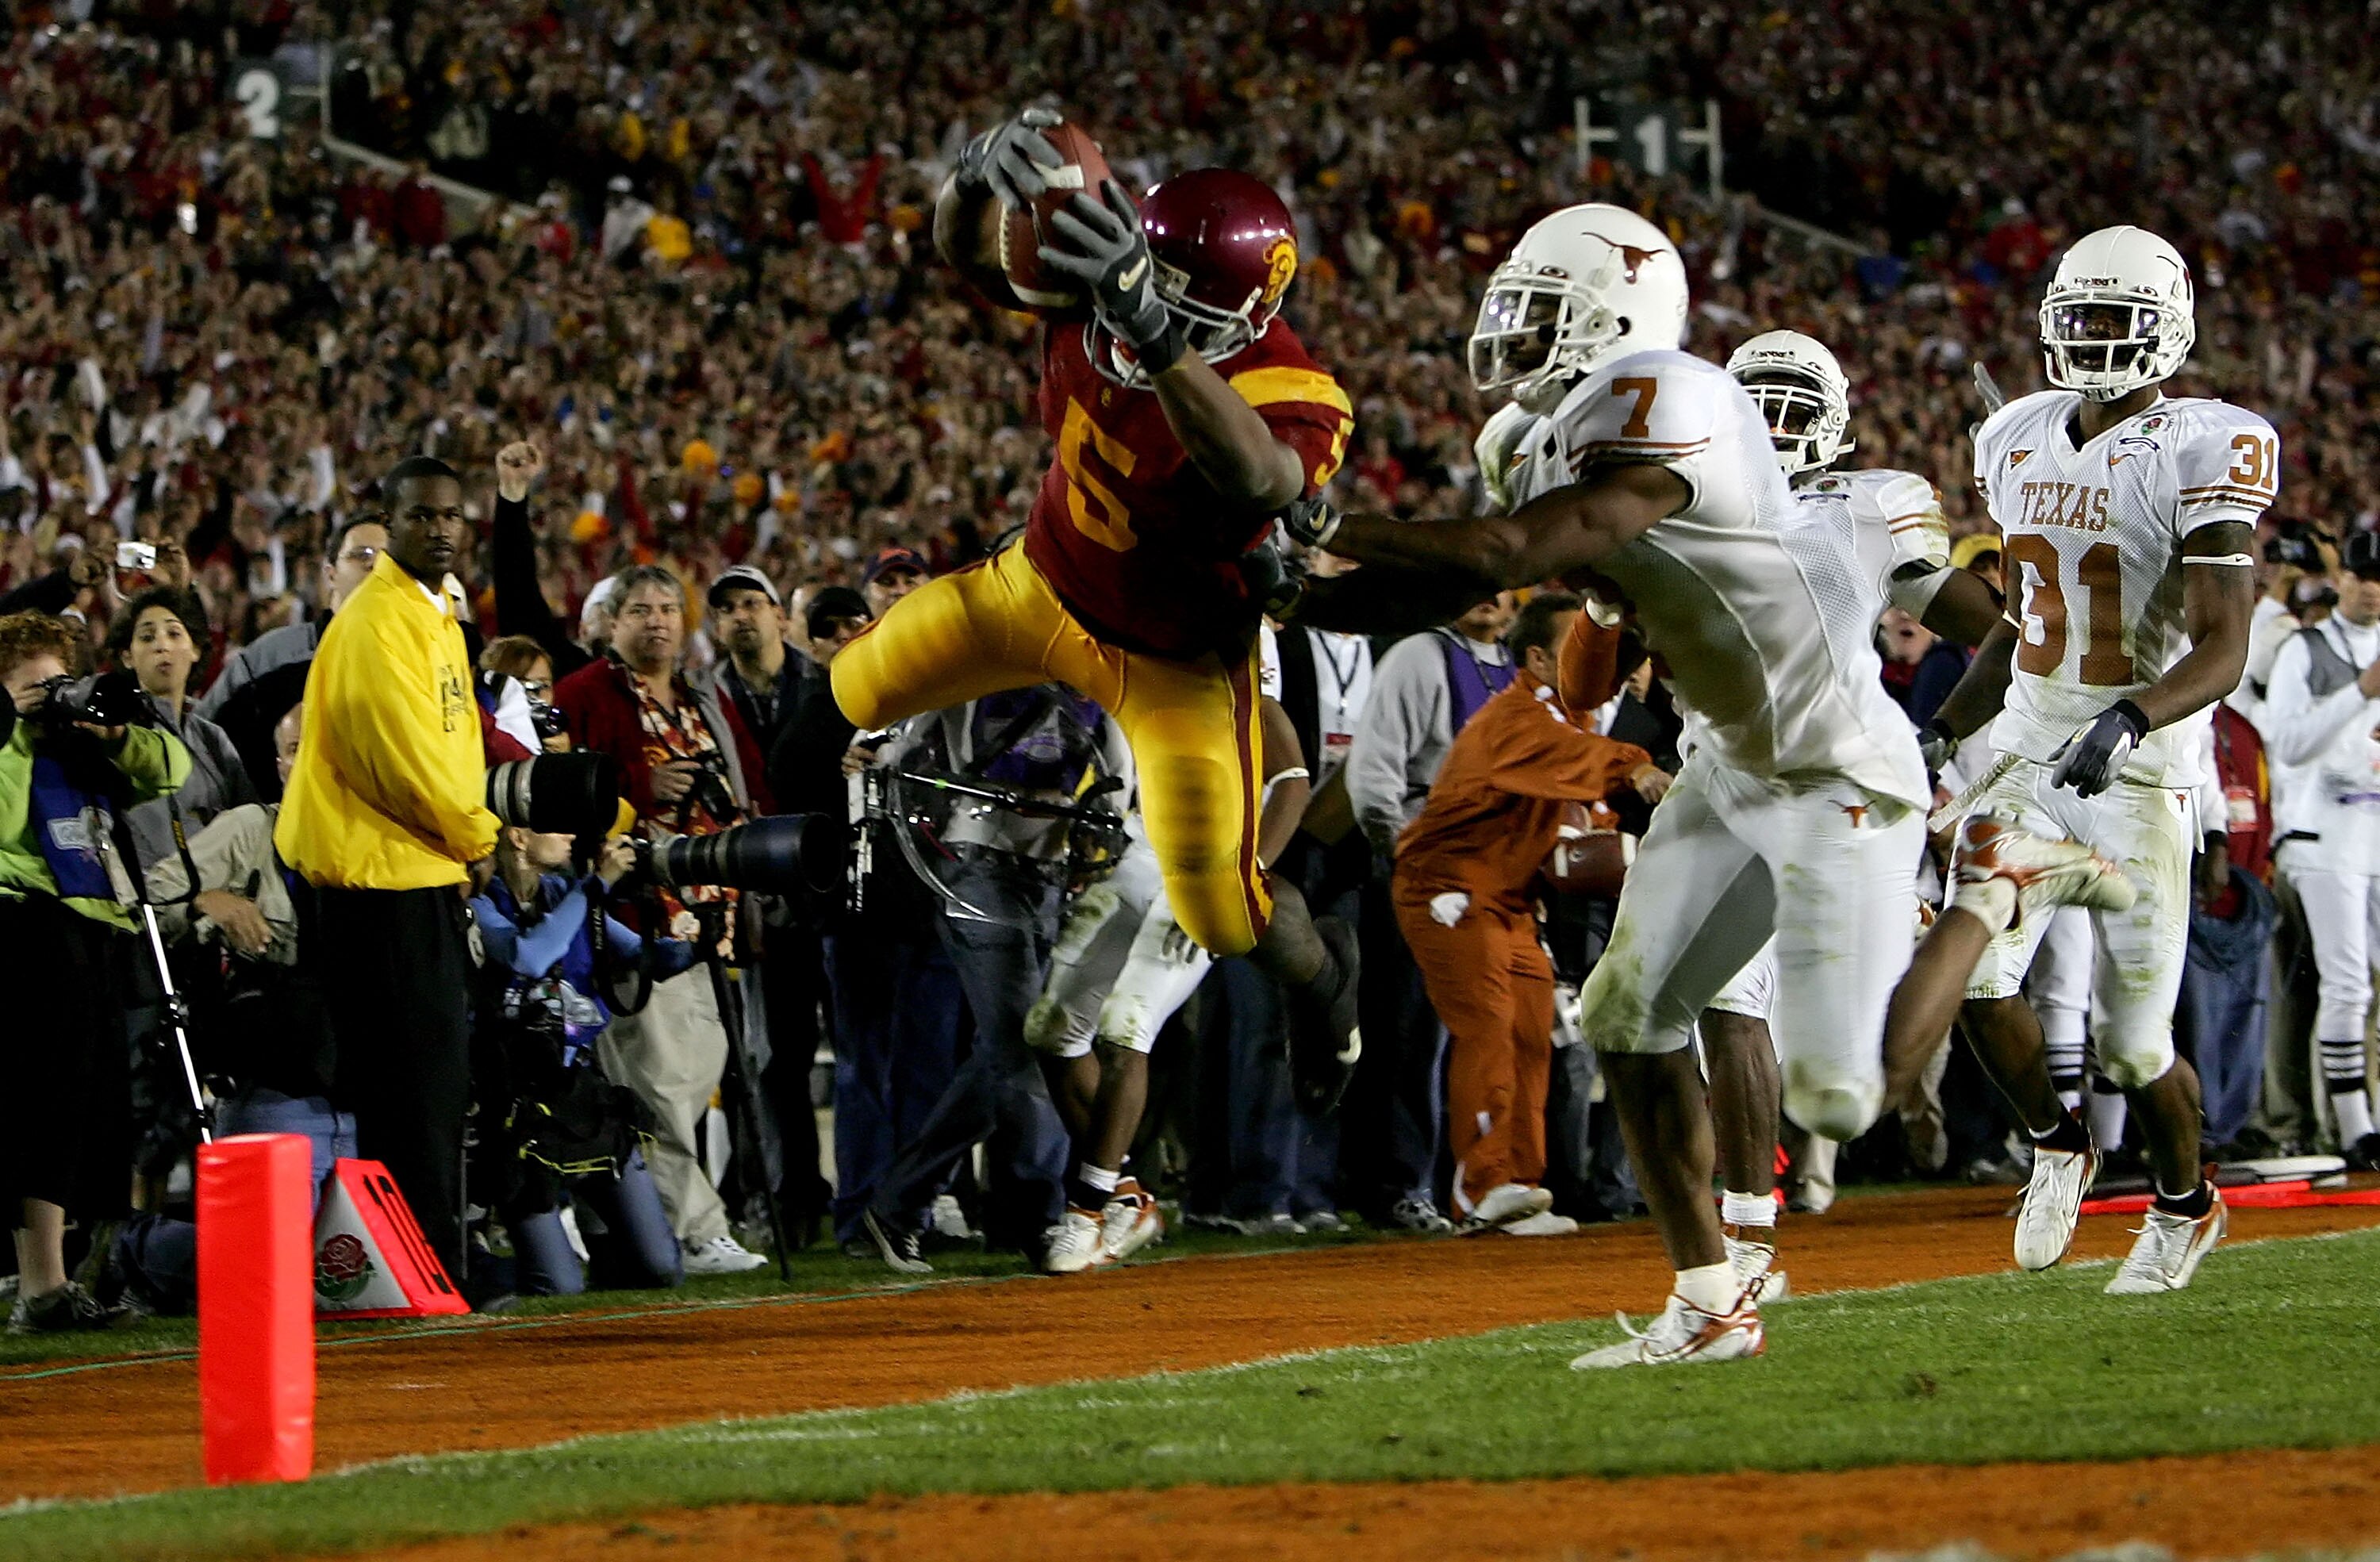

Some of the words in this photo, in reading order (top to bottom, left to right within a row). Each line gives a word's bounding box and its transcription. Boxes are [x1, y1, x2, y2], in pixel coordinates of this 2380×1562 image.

[236, 68, 278, 138] 2
[1634, 115, 1665, 176] 1
[1611, 377, 1657, 438] 7
[2228, 433, 2274, 490] 31
[2019, 482, 2109, 532] TEXAS
[2001, 533, 2133, 686] 31
